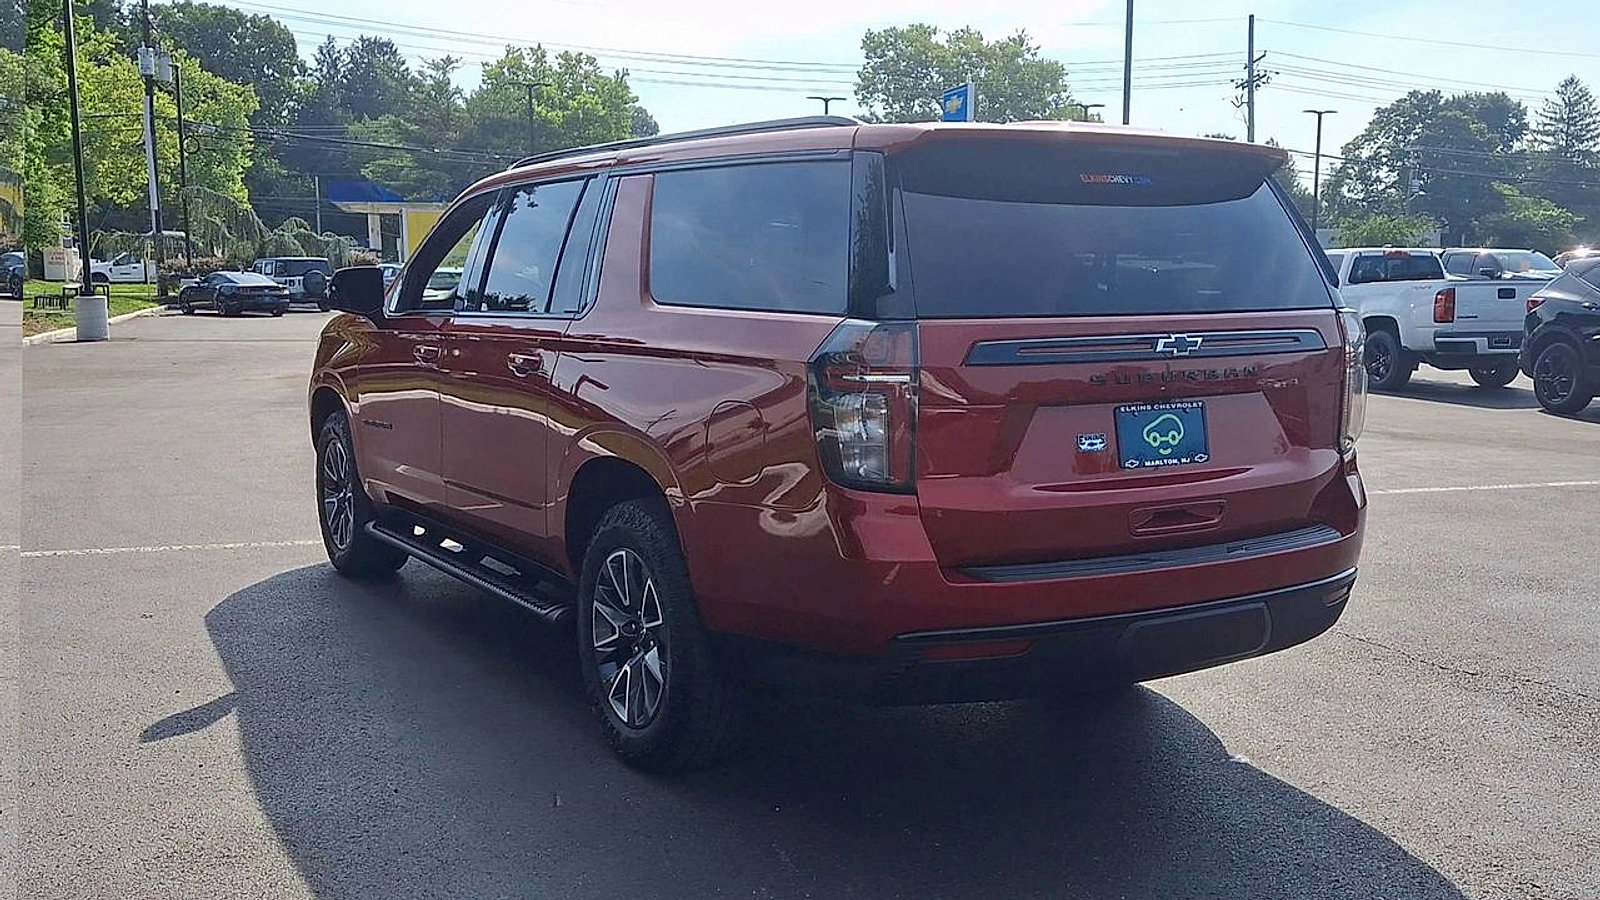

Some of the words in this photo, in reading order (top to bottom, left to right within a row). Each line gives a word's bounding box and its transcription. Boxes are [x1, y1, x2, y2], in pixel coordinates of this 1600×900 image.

[1089, 366, 1259, 385] SUBURBAN
[1120, 404, 1151, 412] ELKINS
[1153, 401, 1203, 410] CHEVROLET
